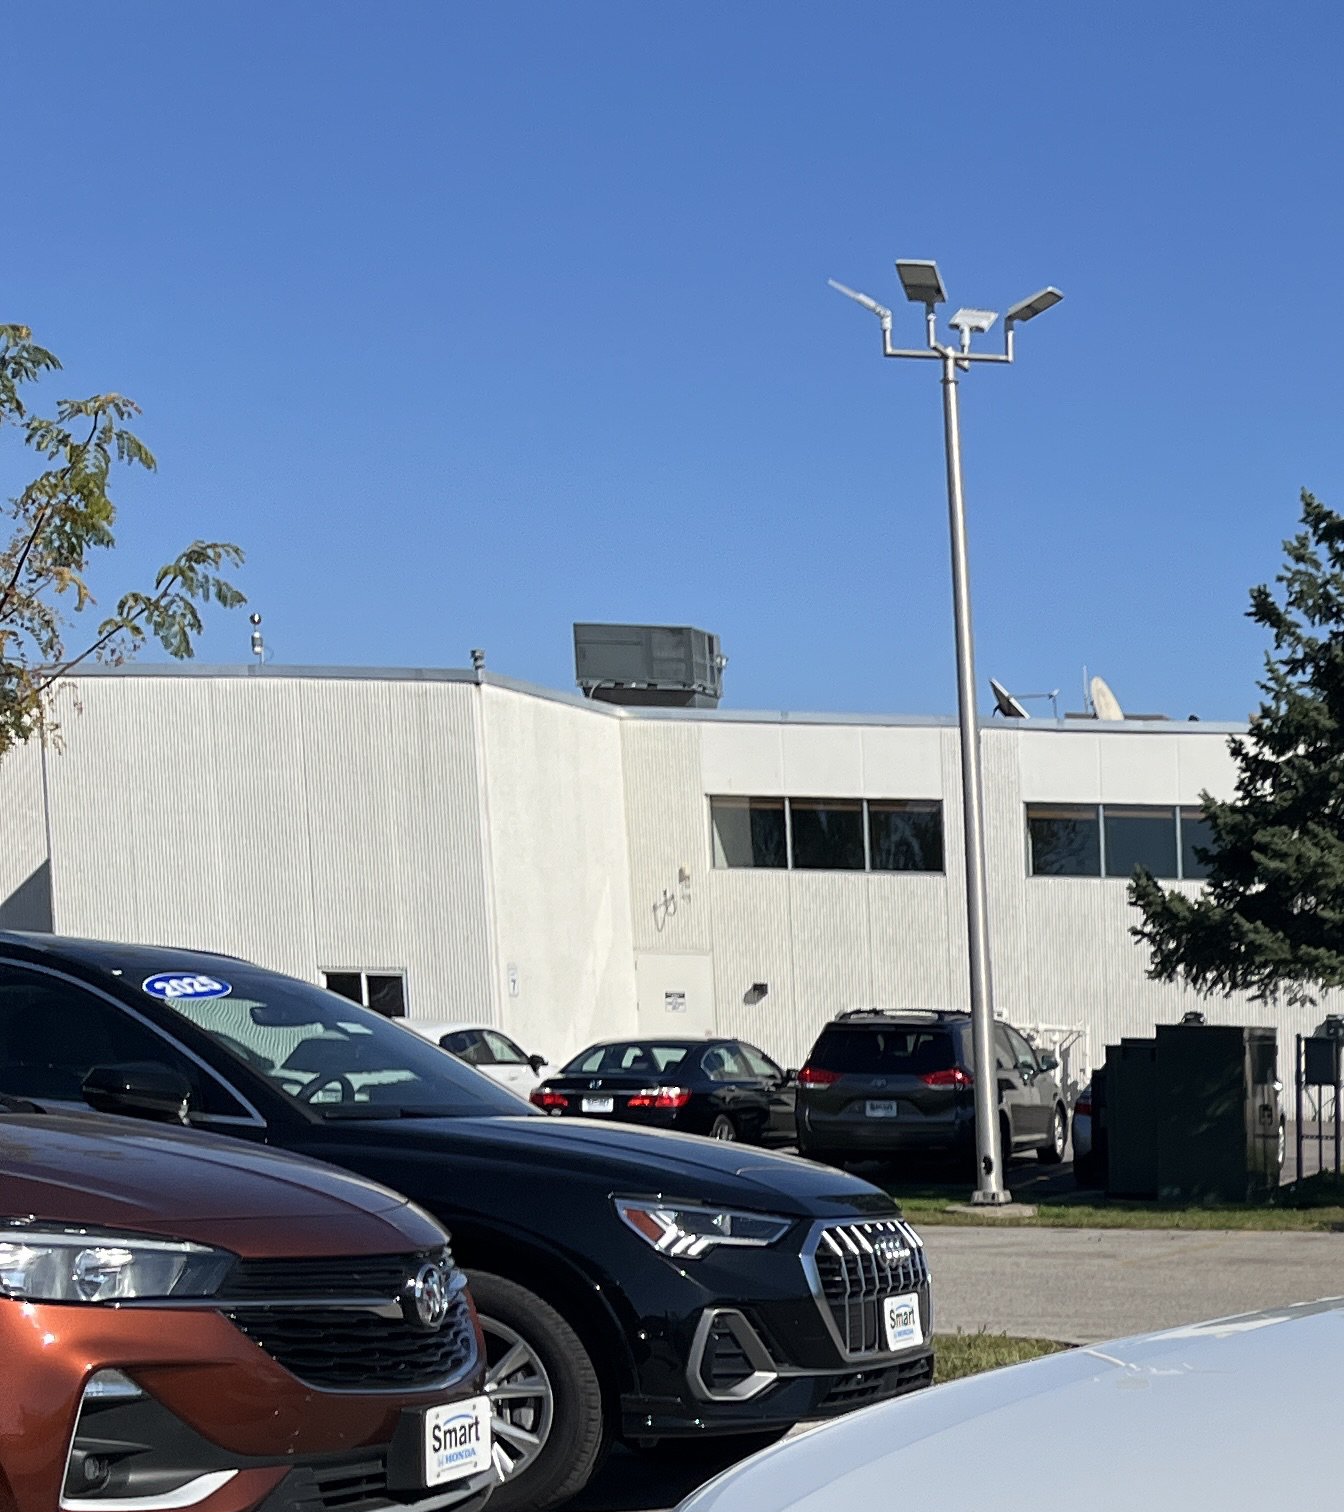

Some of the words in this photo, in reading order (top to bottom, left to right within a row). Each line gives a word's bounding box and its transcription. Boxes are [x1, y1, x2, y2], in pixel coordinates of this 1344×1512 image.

[153, 975, 223, 998] 2025
[890, 1308, 915, 1330] Smart
[432, 1416, 480, 1453] Smart
[445, 1447, 476, 1464] HONDA
